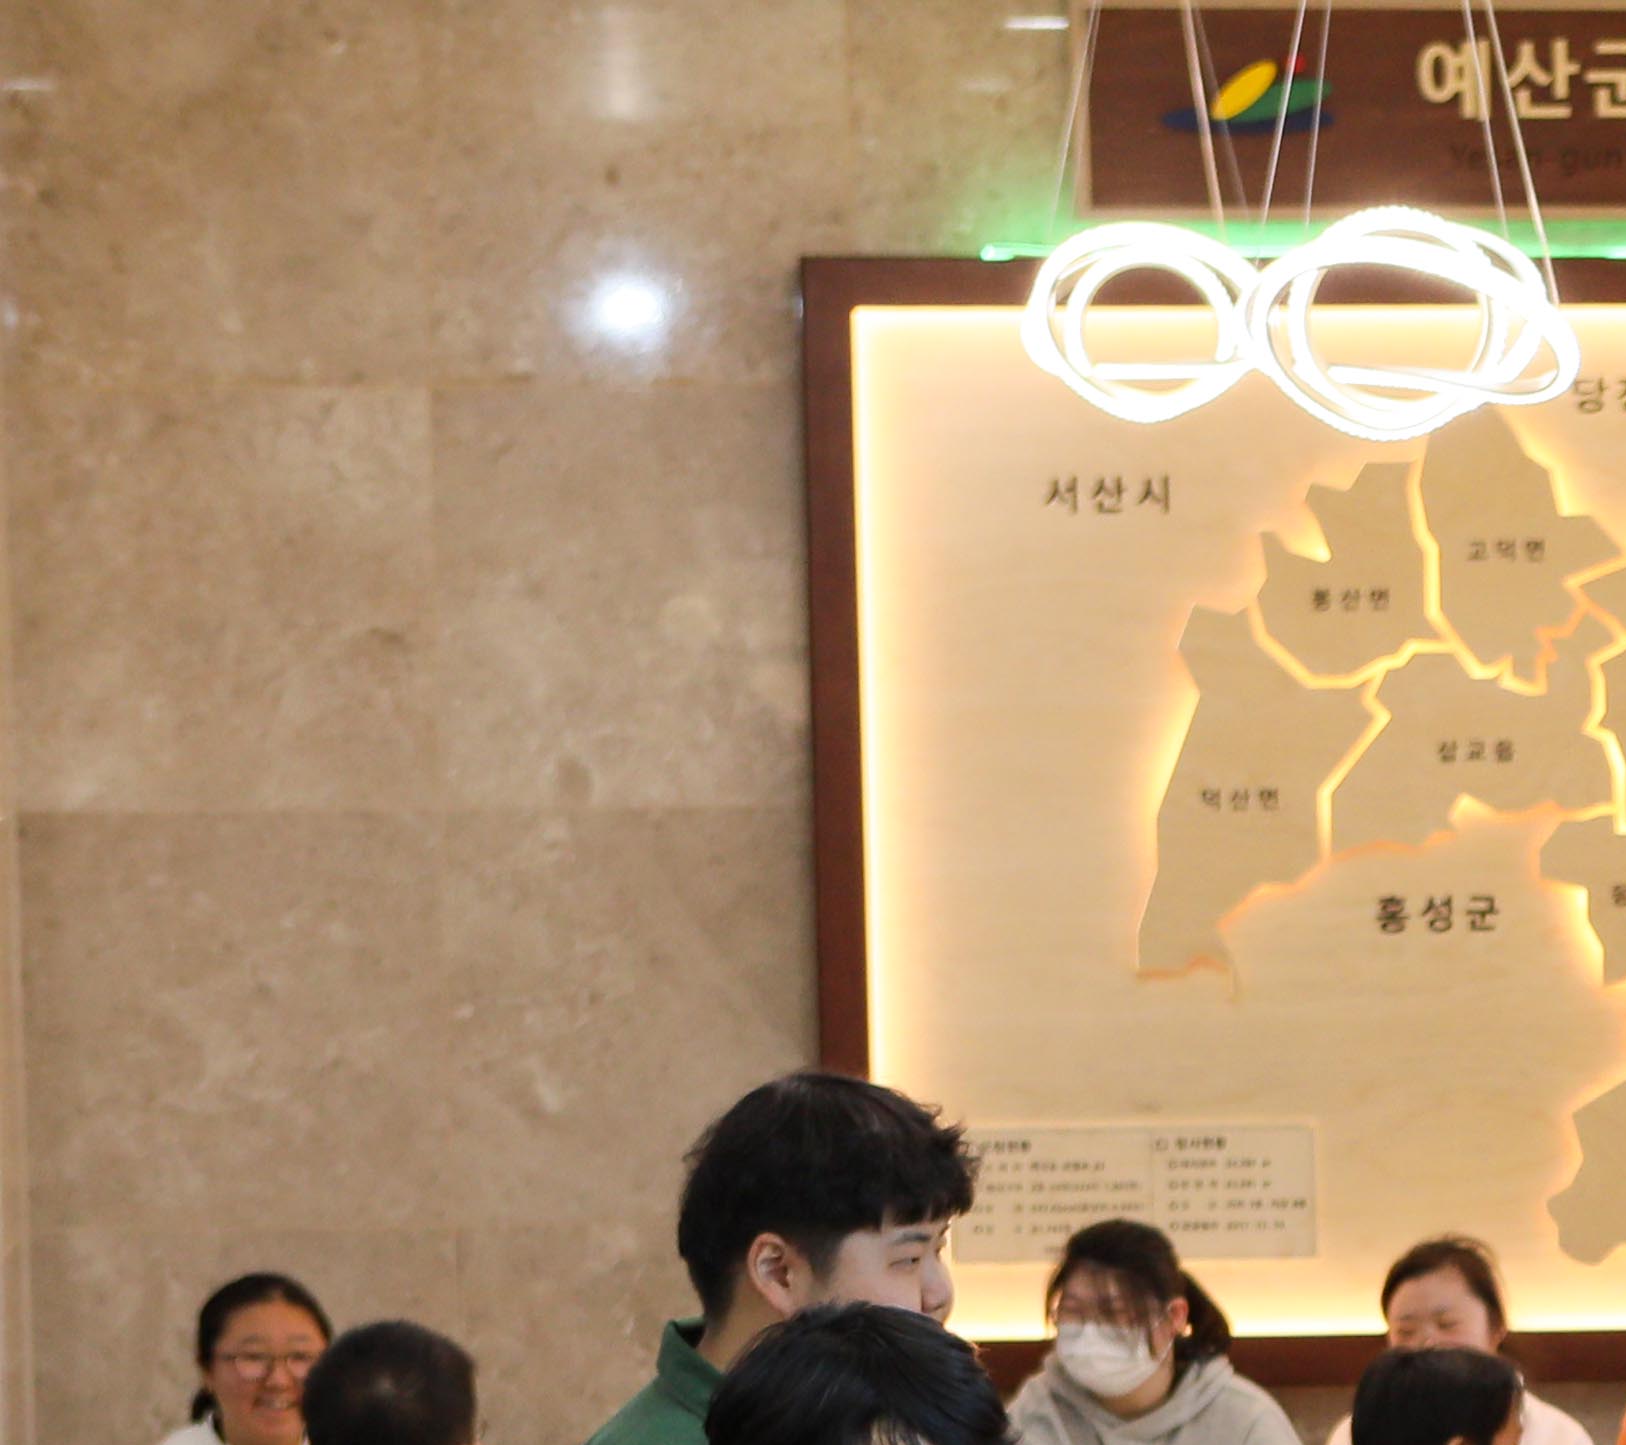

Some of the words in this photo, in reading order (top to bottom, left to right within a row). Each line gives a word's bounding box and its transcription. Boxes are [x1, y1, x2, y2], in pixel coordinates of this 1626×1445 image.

[1045, 474, 1171, 514] 서산시
[1200, 787, 1279, 812] 덕산면
[1376, 894, 1499, 934] 홍성군
